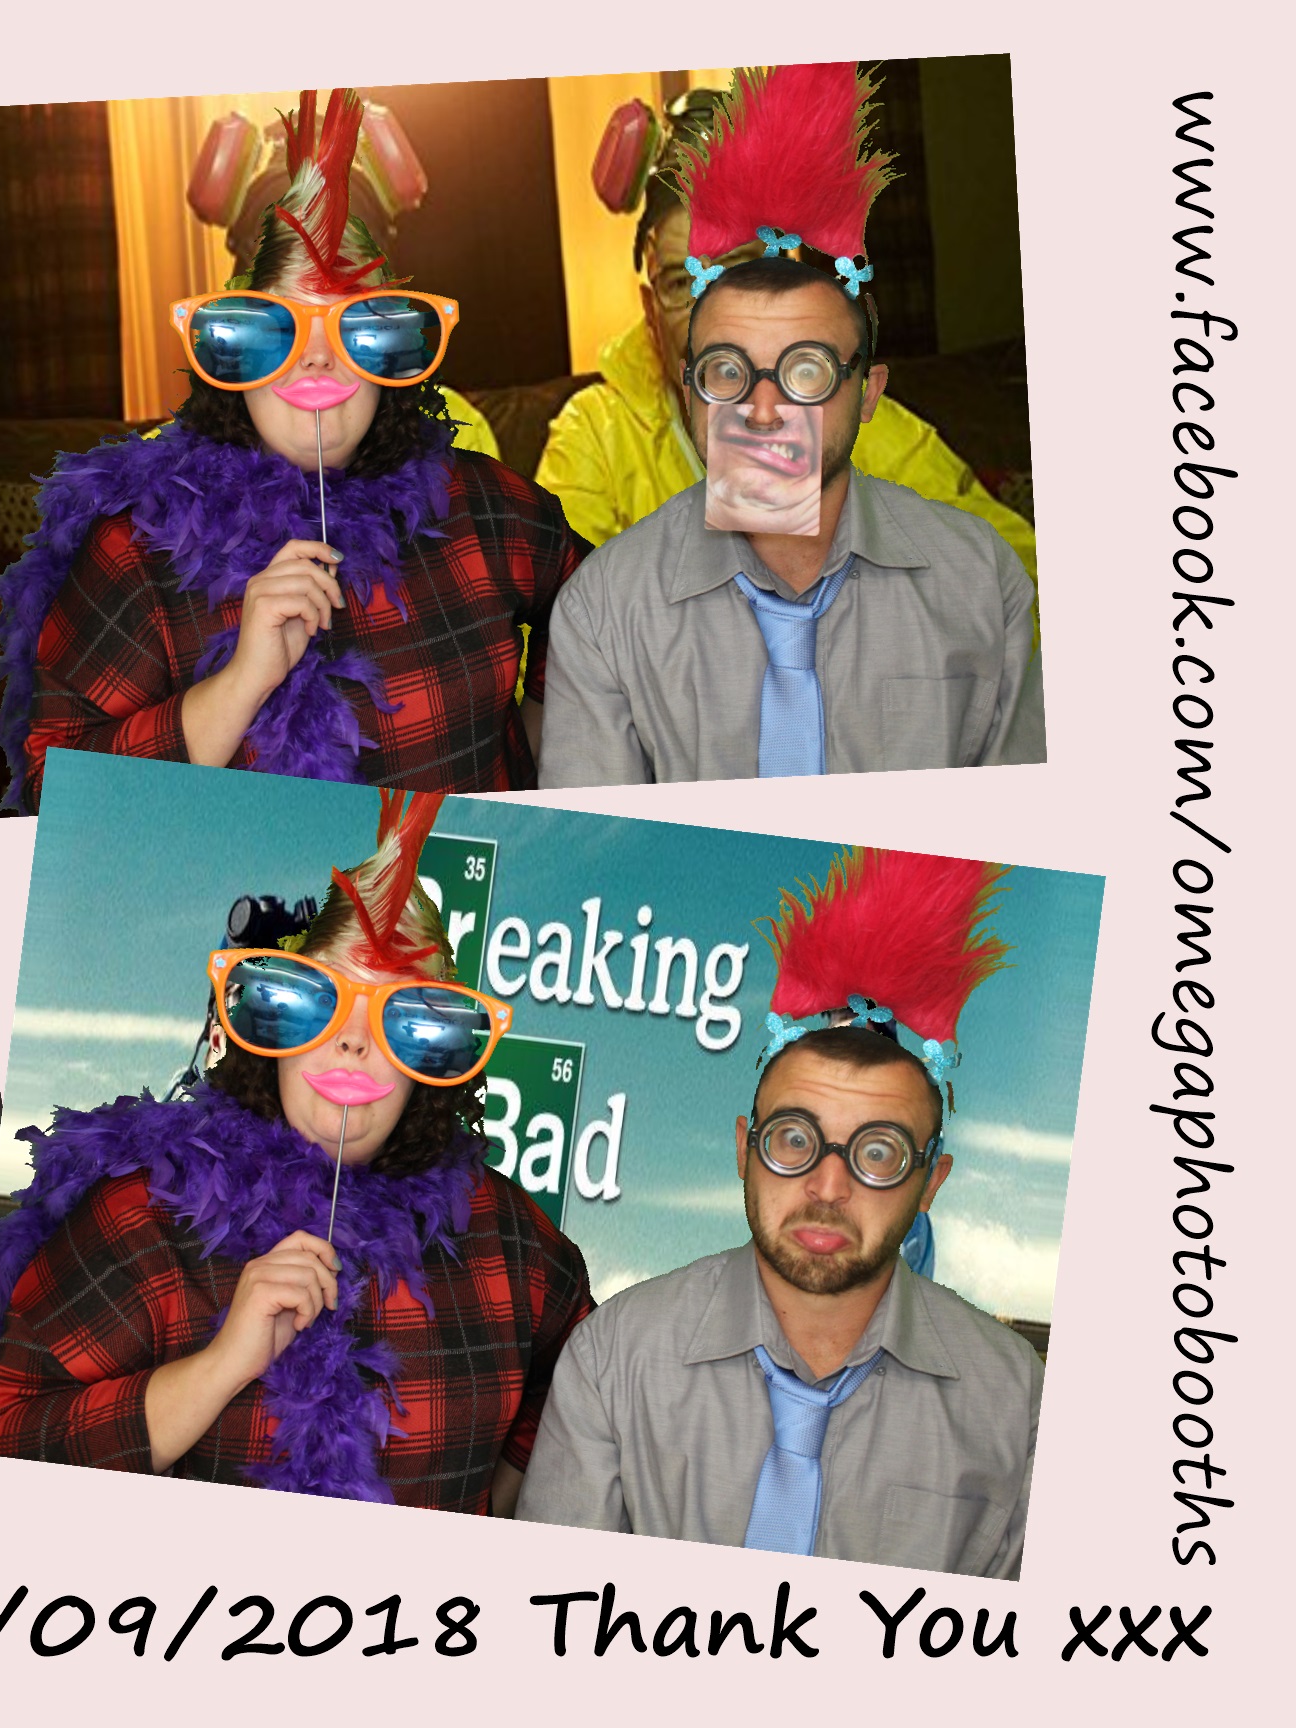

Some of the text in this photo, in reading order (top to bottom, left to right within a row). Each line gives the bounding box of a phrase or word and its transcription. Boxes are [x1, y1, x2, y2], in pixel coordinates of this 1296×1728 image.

[464, 856, 486, 882] 35
[417, 874, 749, 1050] reaking
[550, 1057, 573, 1083] 56
[474, 1075, 627, 1201] Bad
